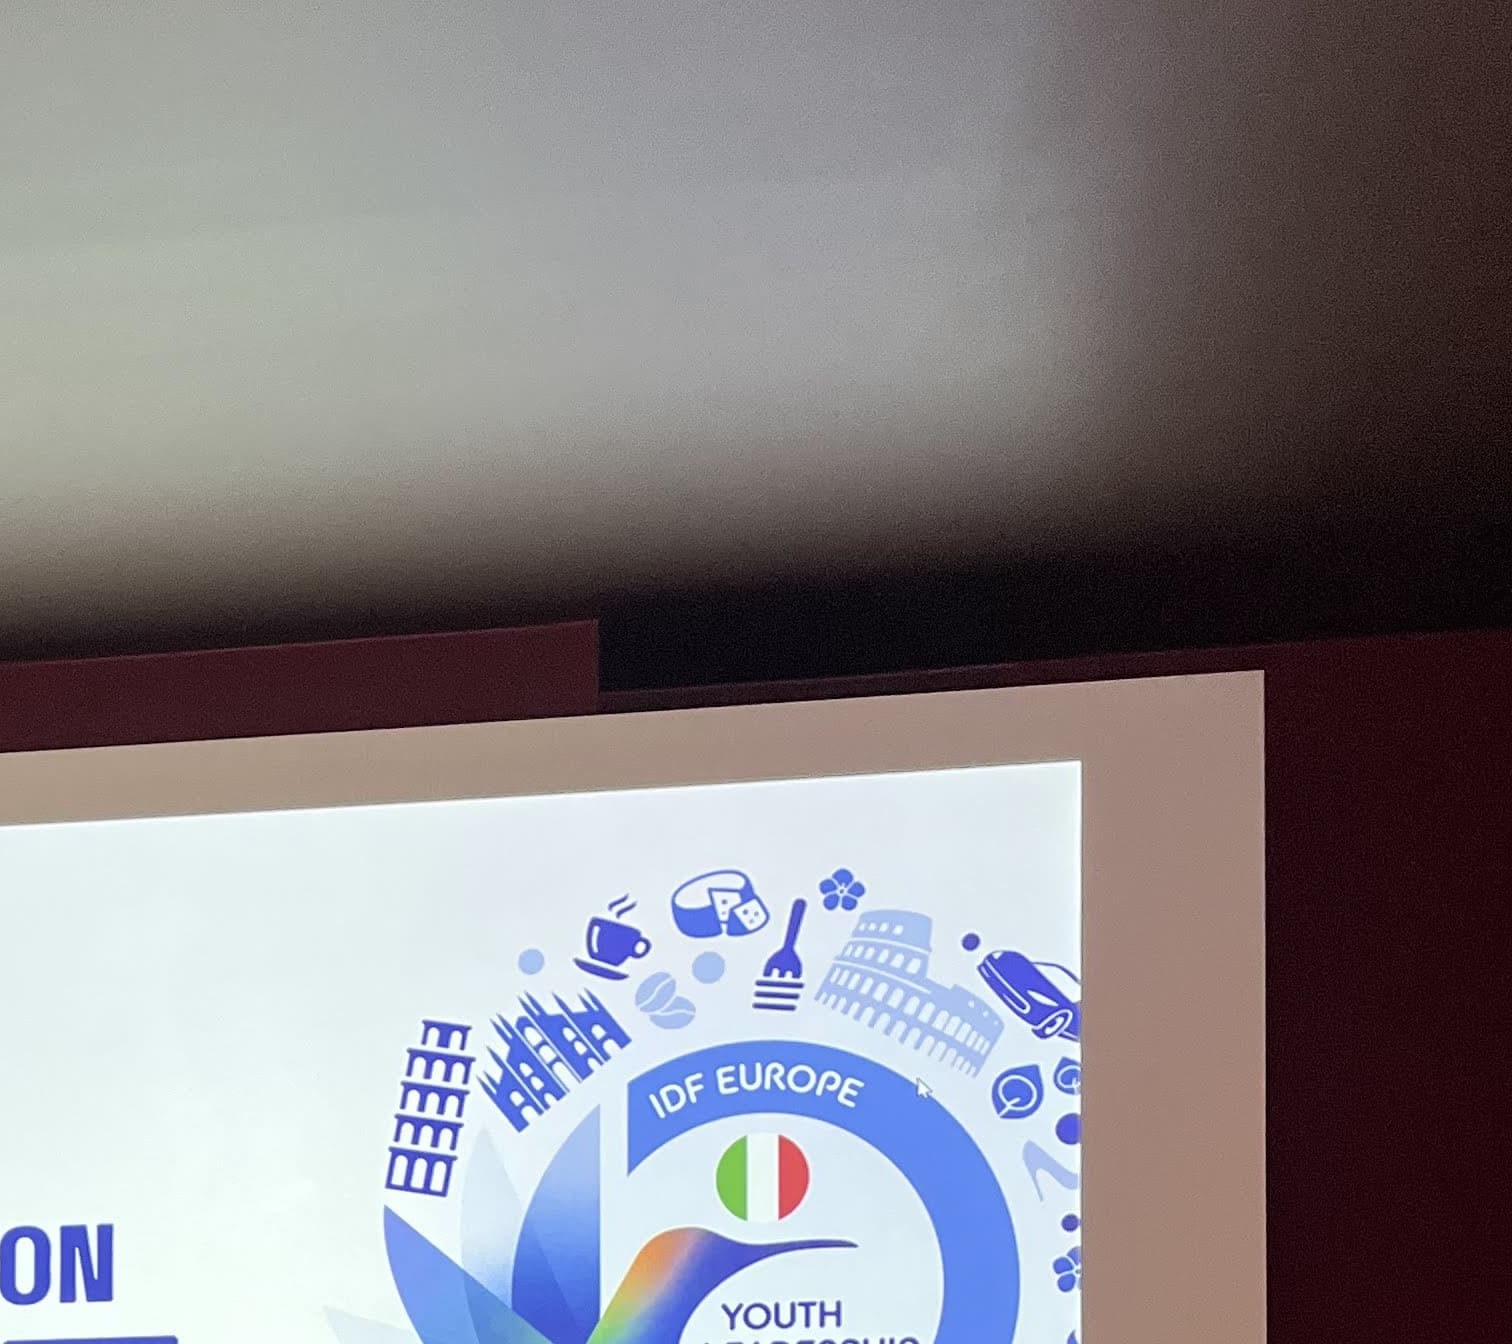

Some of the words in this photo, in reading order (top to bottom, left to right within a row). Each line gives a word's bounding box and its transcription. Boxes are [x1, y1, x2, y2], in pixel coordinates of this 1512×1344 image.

[649, 1072, 705, 1118] IDF
[716, 1062, 865, 1107] EUROPE
[721, 1301, 843, 1331] YOUTH
